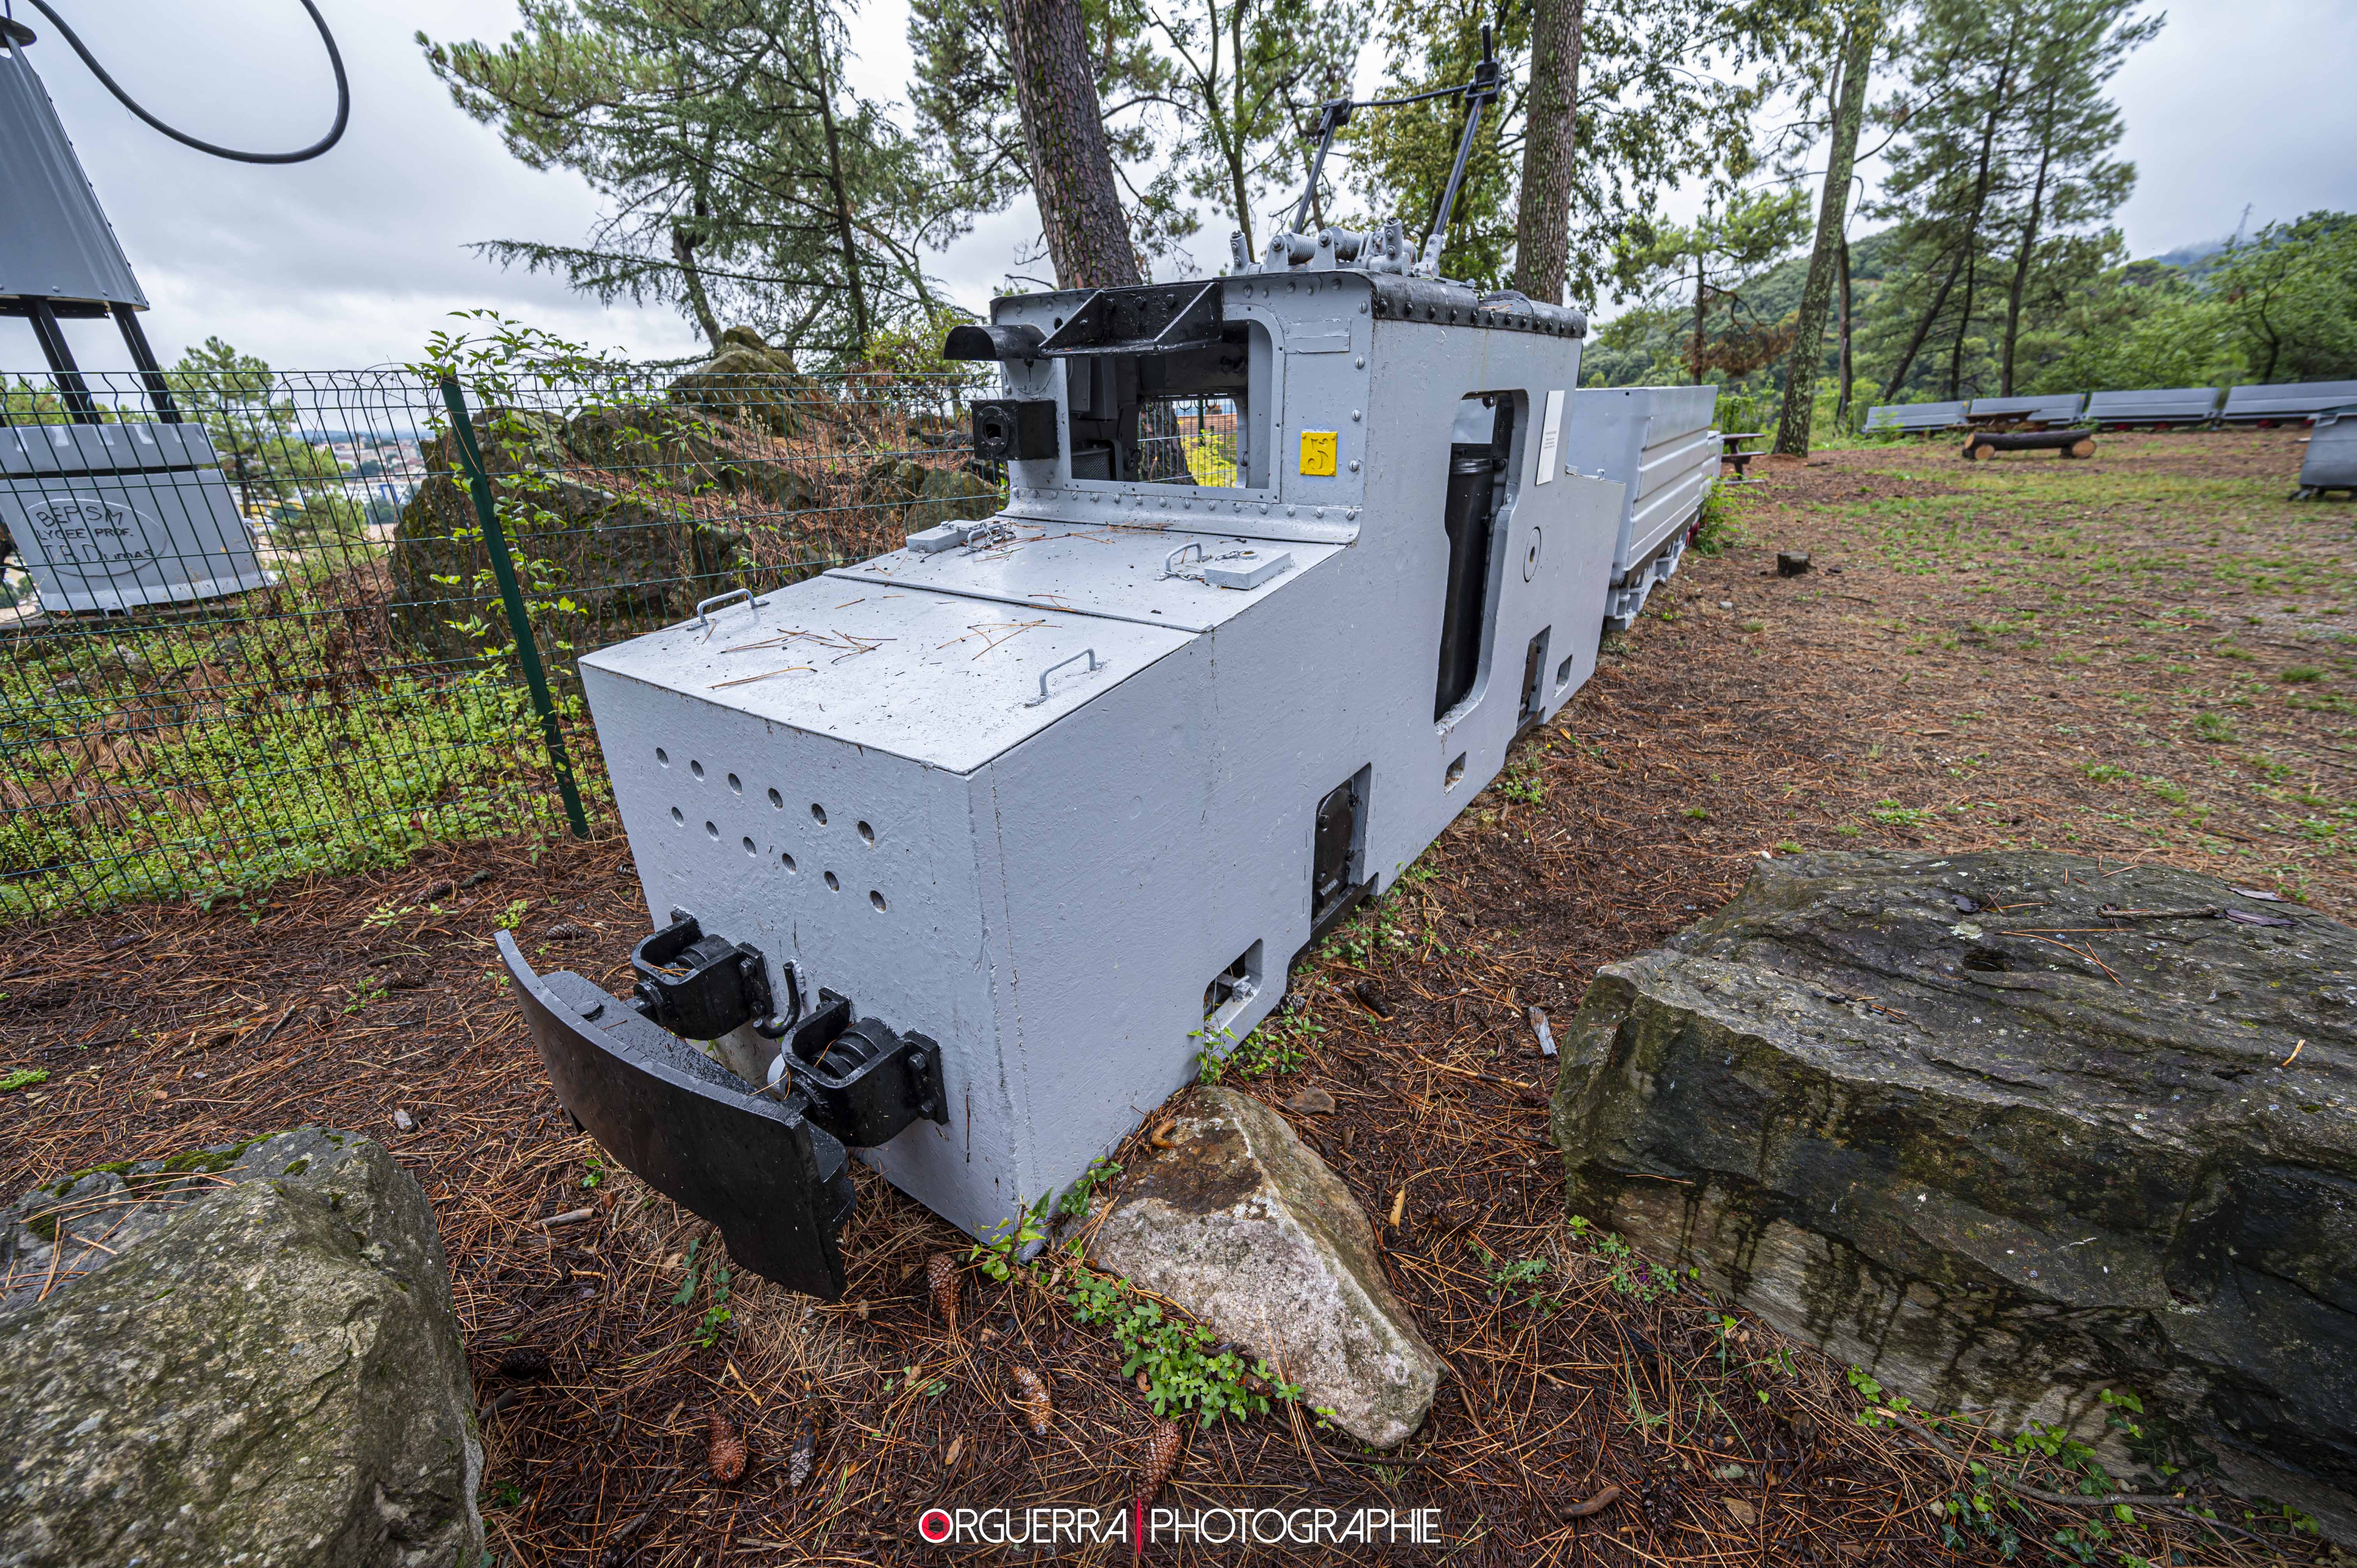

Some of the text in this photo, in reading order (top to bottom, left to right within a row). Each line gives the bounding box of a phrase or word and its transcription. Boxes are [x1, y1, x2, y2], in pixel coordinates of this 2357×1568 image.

[1307, 437, 1329, 470] 5
[36, 506, 123, 527] BEP SM
[36, 528, 134, 540] LYCEE PROF.
